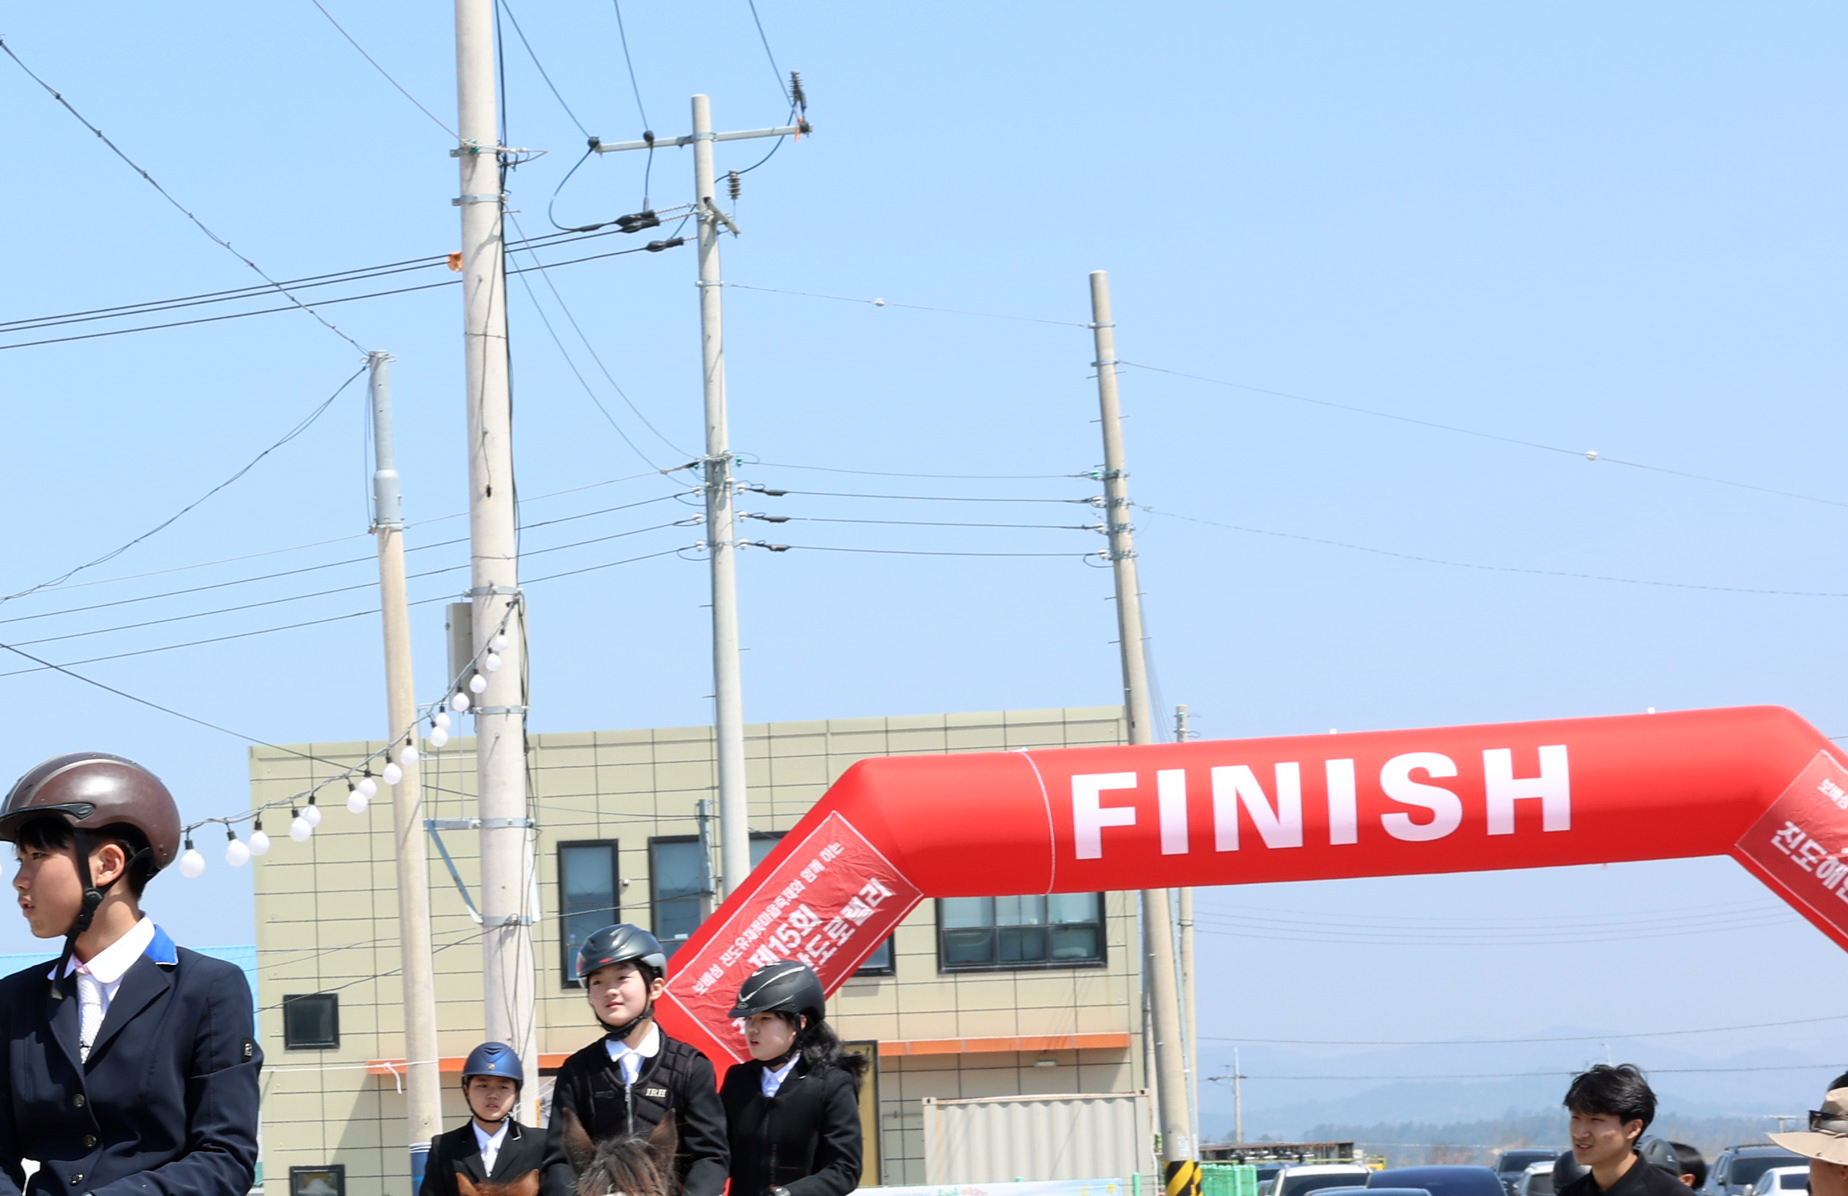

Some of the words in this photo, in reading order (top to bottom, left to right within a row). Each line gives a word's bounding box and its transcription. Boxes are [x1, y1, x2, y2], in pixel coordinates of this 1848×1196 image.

[1071, 744, 1571, 860] FINISH
[692, 964, 725, 996] 보배섬
[799, 858, 827, 884] 함께
[819, 841, 845, 863] 하는
[747, 902, 824, 968] 제15회
